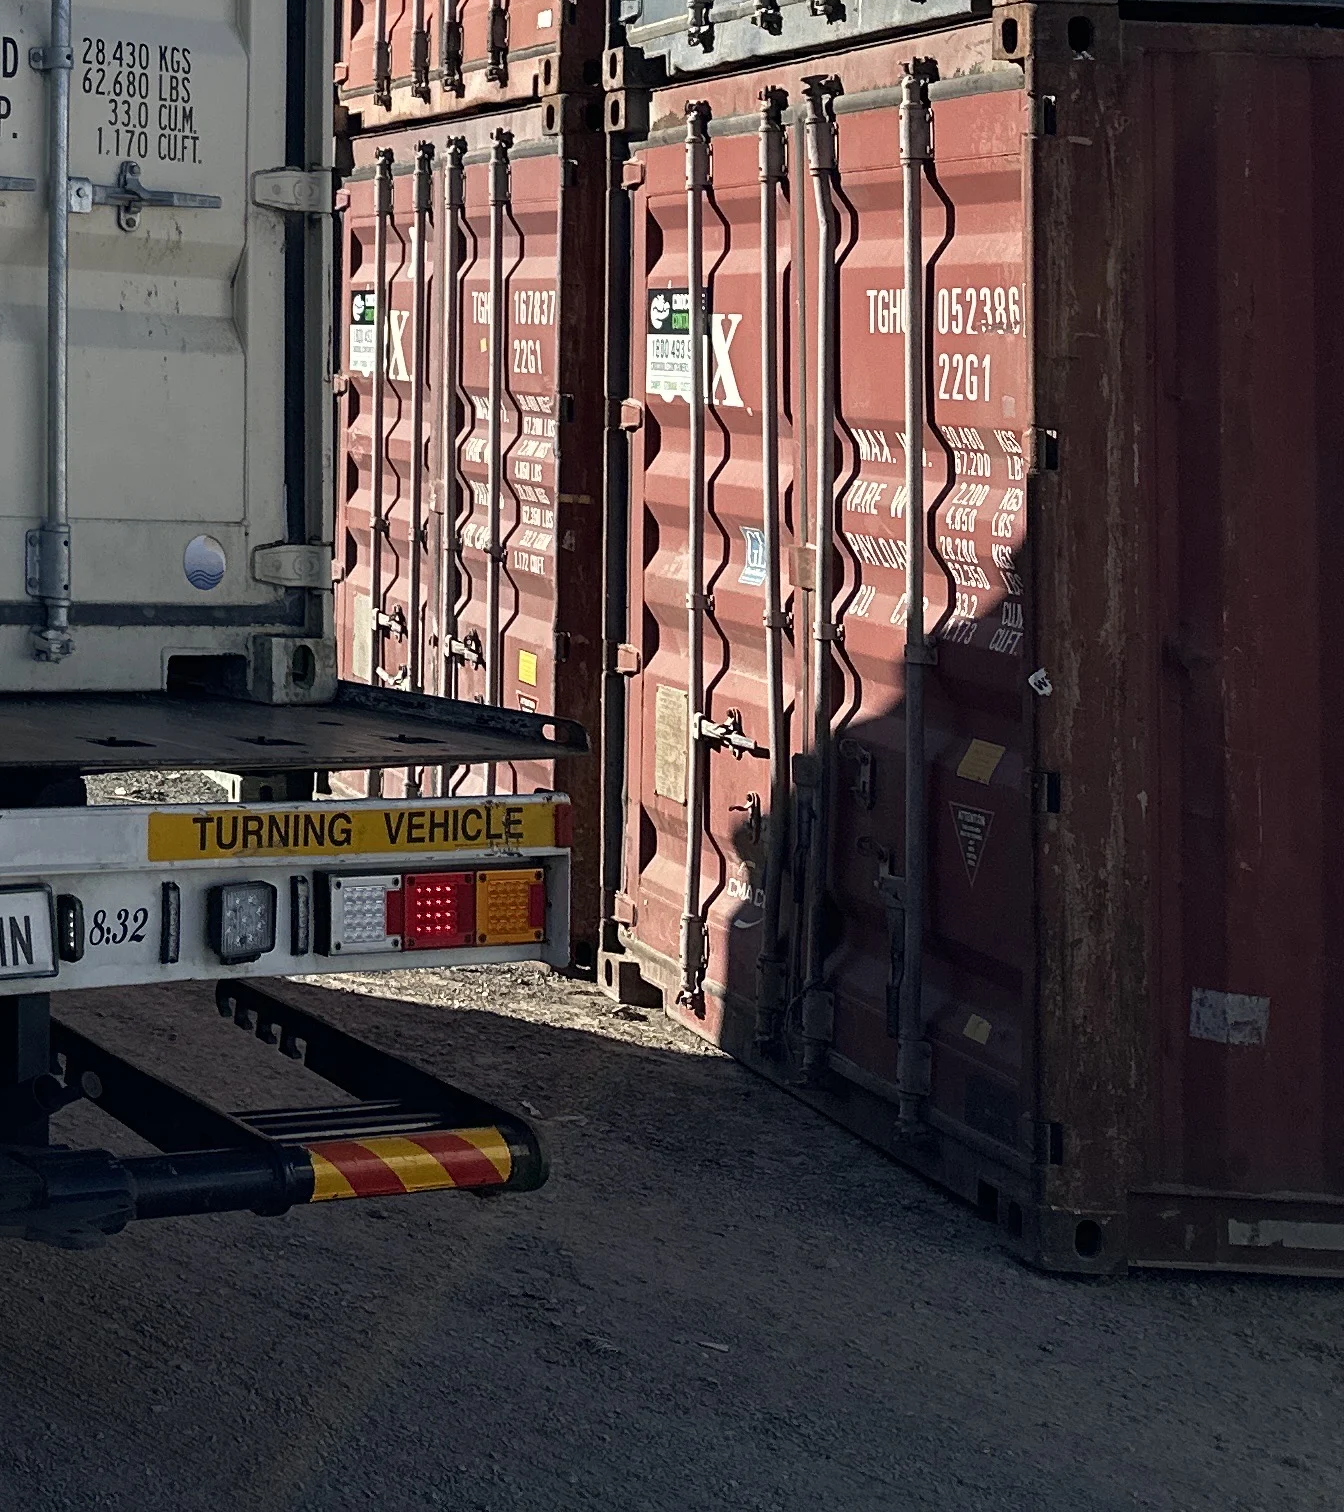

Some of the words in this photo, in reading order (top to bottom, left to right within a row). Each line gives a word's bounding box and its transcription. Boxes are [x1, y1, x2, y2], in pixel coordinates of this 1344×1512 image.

[158, 45, 192, 75] KGS
[158, 73, 191, 104] LBS
[108, 98, 149, 129] 33.0
[514, 290, 555, 325] 167837
[937, 287, 1021, 335] 052386
[938, 353, 991, 402] 22G1
[850, 428, 897, 464] MAX.
[993, 429, 1022, 454] KGS
[846, 479, 888, 515] TARE
[991, 511, 1015, 538] LBS
[192, 811, 353, 851] TURNING
[384, 806, 525, 845] VEHICLE
